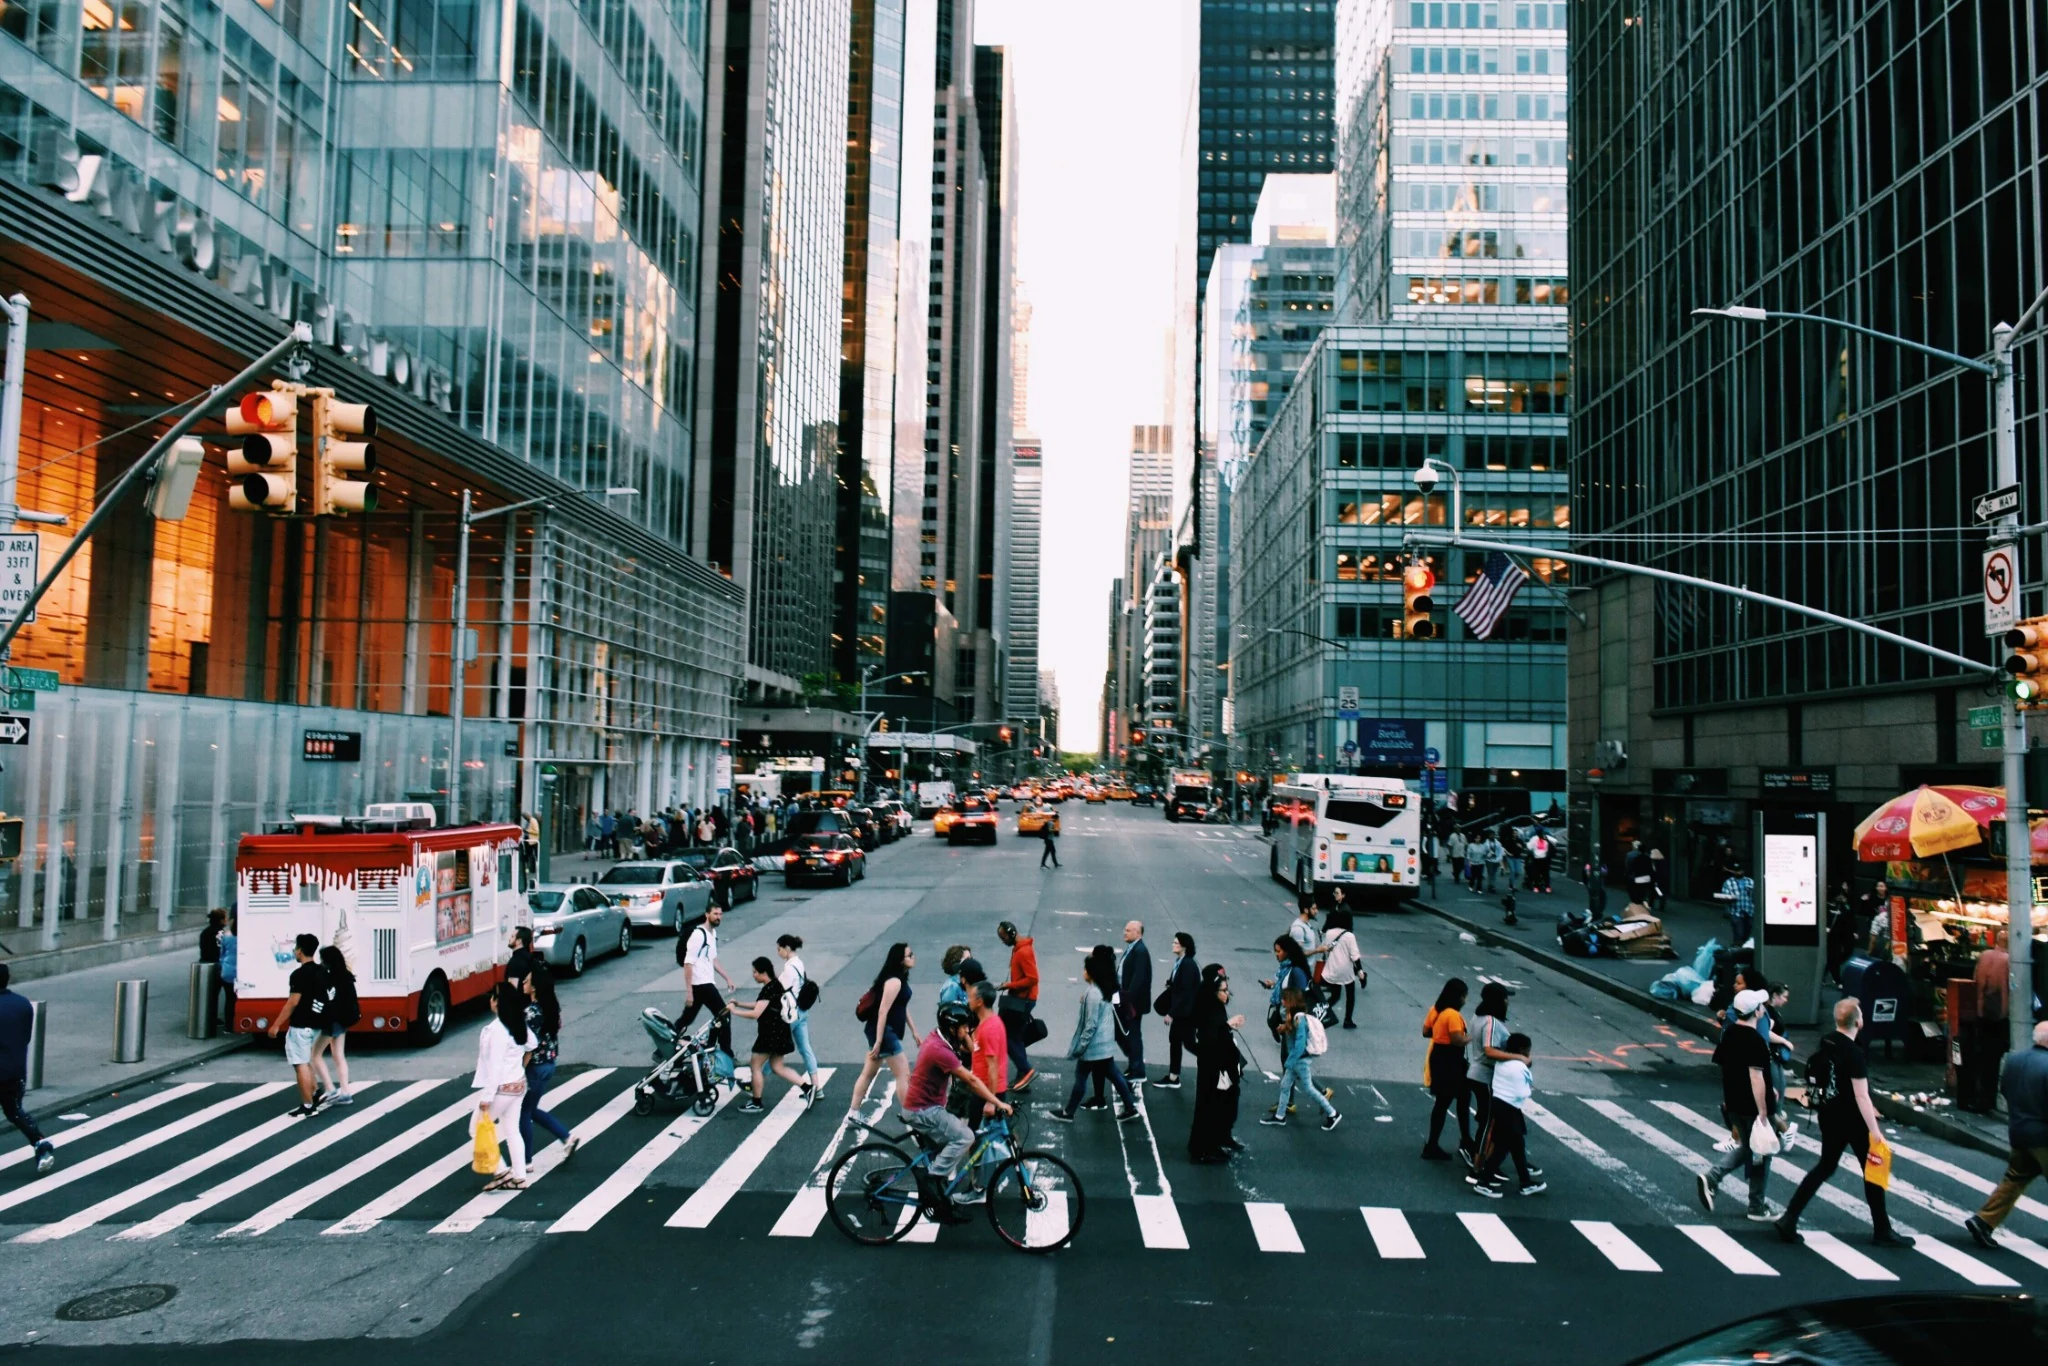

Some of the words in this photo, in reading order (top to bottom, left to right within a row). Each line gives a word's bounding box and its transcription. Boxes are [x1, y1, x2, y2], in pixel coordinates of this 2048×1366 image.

[1980, 501, 1993, 515] ONE
[1999, 494, 2014, 507] WAY
[9, 540, 33, 552] AREA
[14, 573, 21, 585] &
[3, 589, 31, 601] OVER
[12, 675, 56, 691] AMERICAS
[12, 693, 20, 708] 6
[1341, 699, 1357, 709] 25
[5, 725, 21, 735] WAY
[1378, 729, 1406, 739] Retail
[1369, 740, 1414, 749] Available
[1985, 731, 1991, 746] 6
